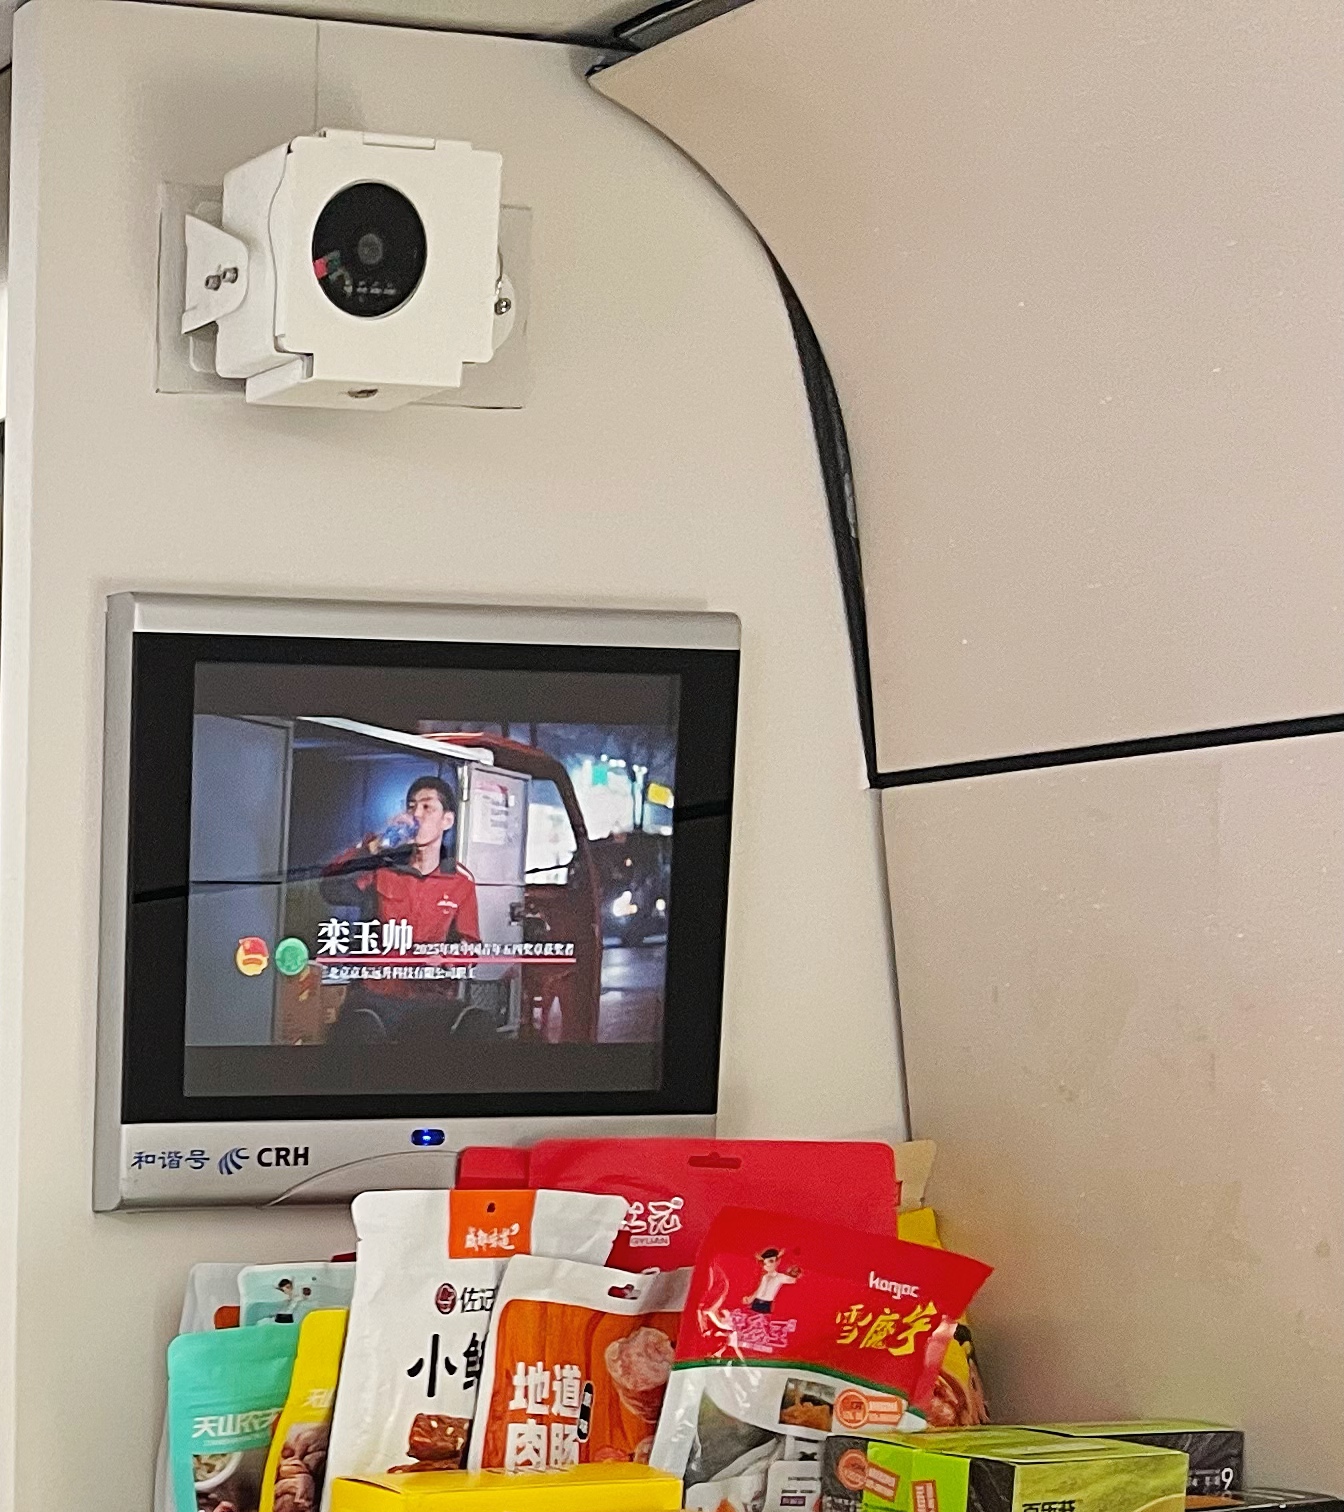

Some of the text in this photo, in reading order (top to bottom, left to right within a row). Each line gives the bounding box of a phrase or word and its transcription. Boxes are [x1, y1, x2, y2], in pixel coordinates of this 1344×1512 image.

[317, 918, 413, 956] 栾玉帅
[131, 1146, 309, 1171] 和谐号 CRH
[836, 1301, 936, 1356] 雪魔芋
[510, 1362, 581, 1417] 地道
[510, 1418, 581, 1472] 肉肠
